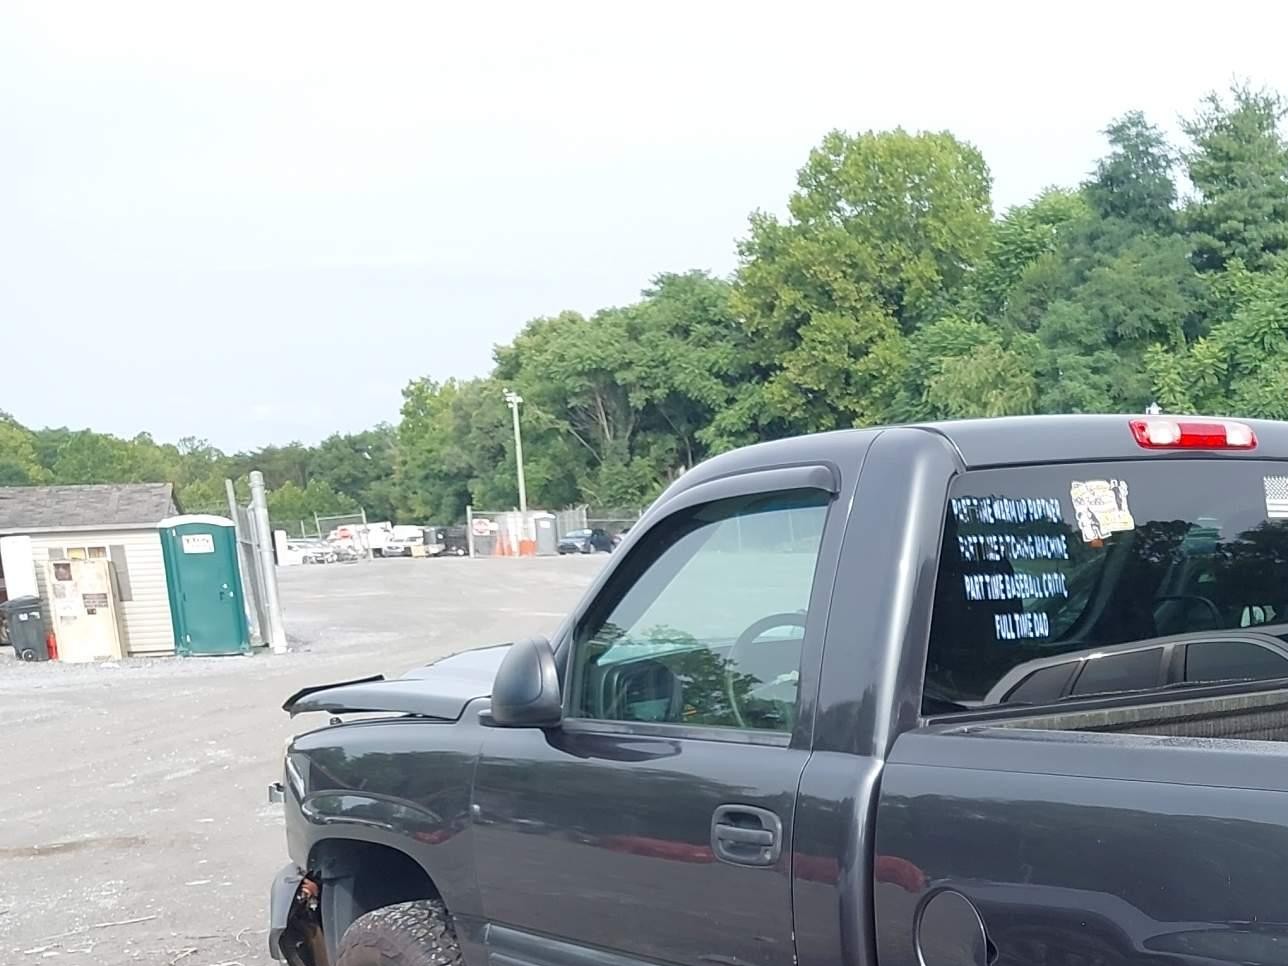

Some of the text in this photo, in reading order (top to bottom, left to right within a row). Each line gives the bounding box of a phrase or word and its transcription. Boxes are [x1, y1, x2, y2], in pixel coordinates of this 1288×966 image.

[993, 498, 1018, 523] WARM
[1016, 498, 1027, 523] UP
[1034, 534, 1069, 560] MACHINE
[963, 572, 1069, 600] PART TIME BASEBALL CRITIC
[994, 612, 1049, 640] FULL TIME DAD
